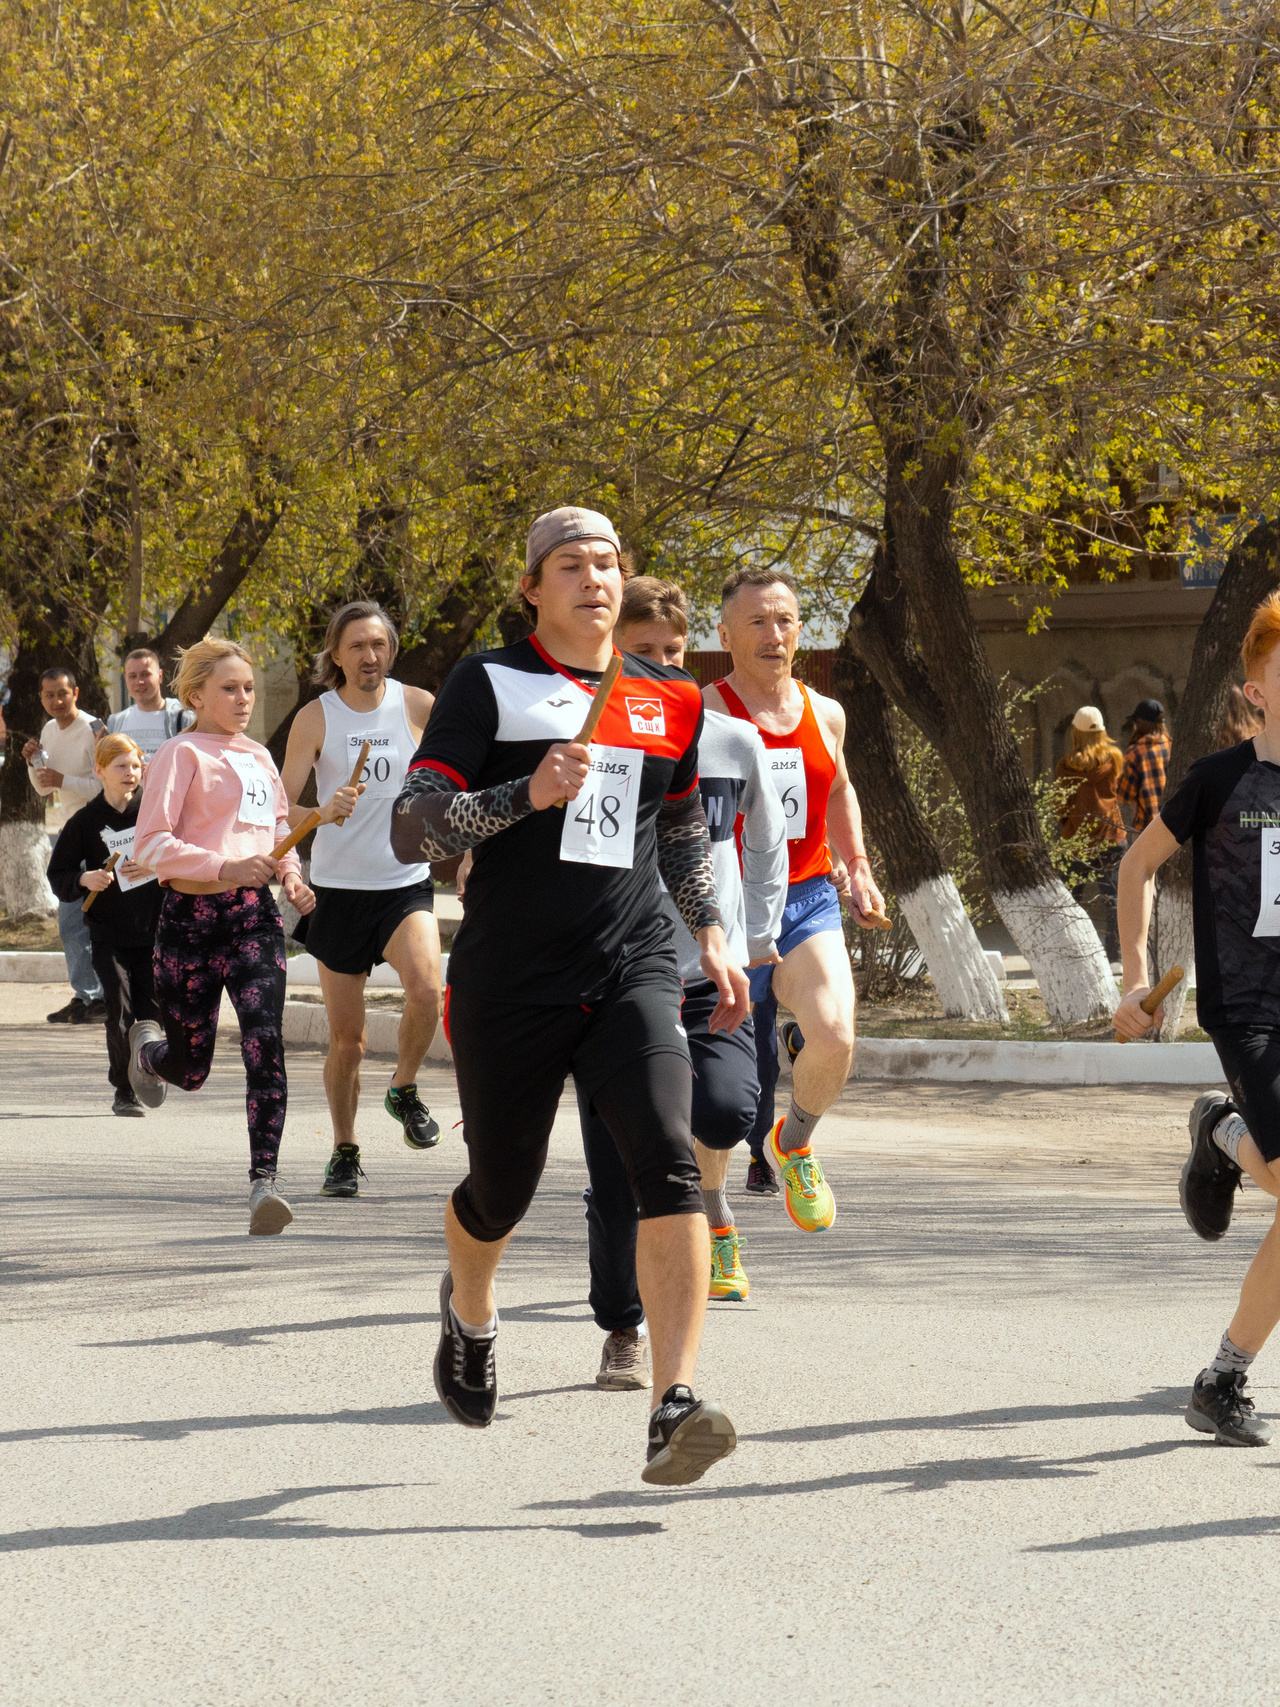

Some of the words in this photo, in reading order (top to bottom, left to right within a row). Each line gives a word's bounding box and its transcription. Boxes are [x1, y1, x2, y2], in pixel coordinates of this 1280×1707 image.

[637, 721, 661, 733] СЩК
[587, 760, 629, 775] намя
[771, 761, 798, 770] амя
[246, 778, 267, 807] 43
[781, 785, 799, 819] 6
[574, 793, 621, 838] 48
[109, 836, 135, 849] Знам
